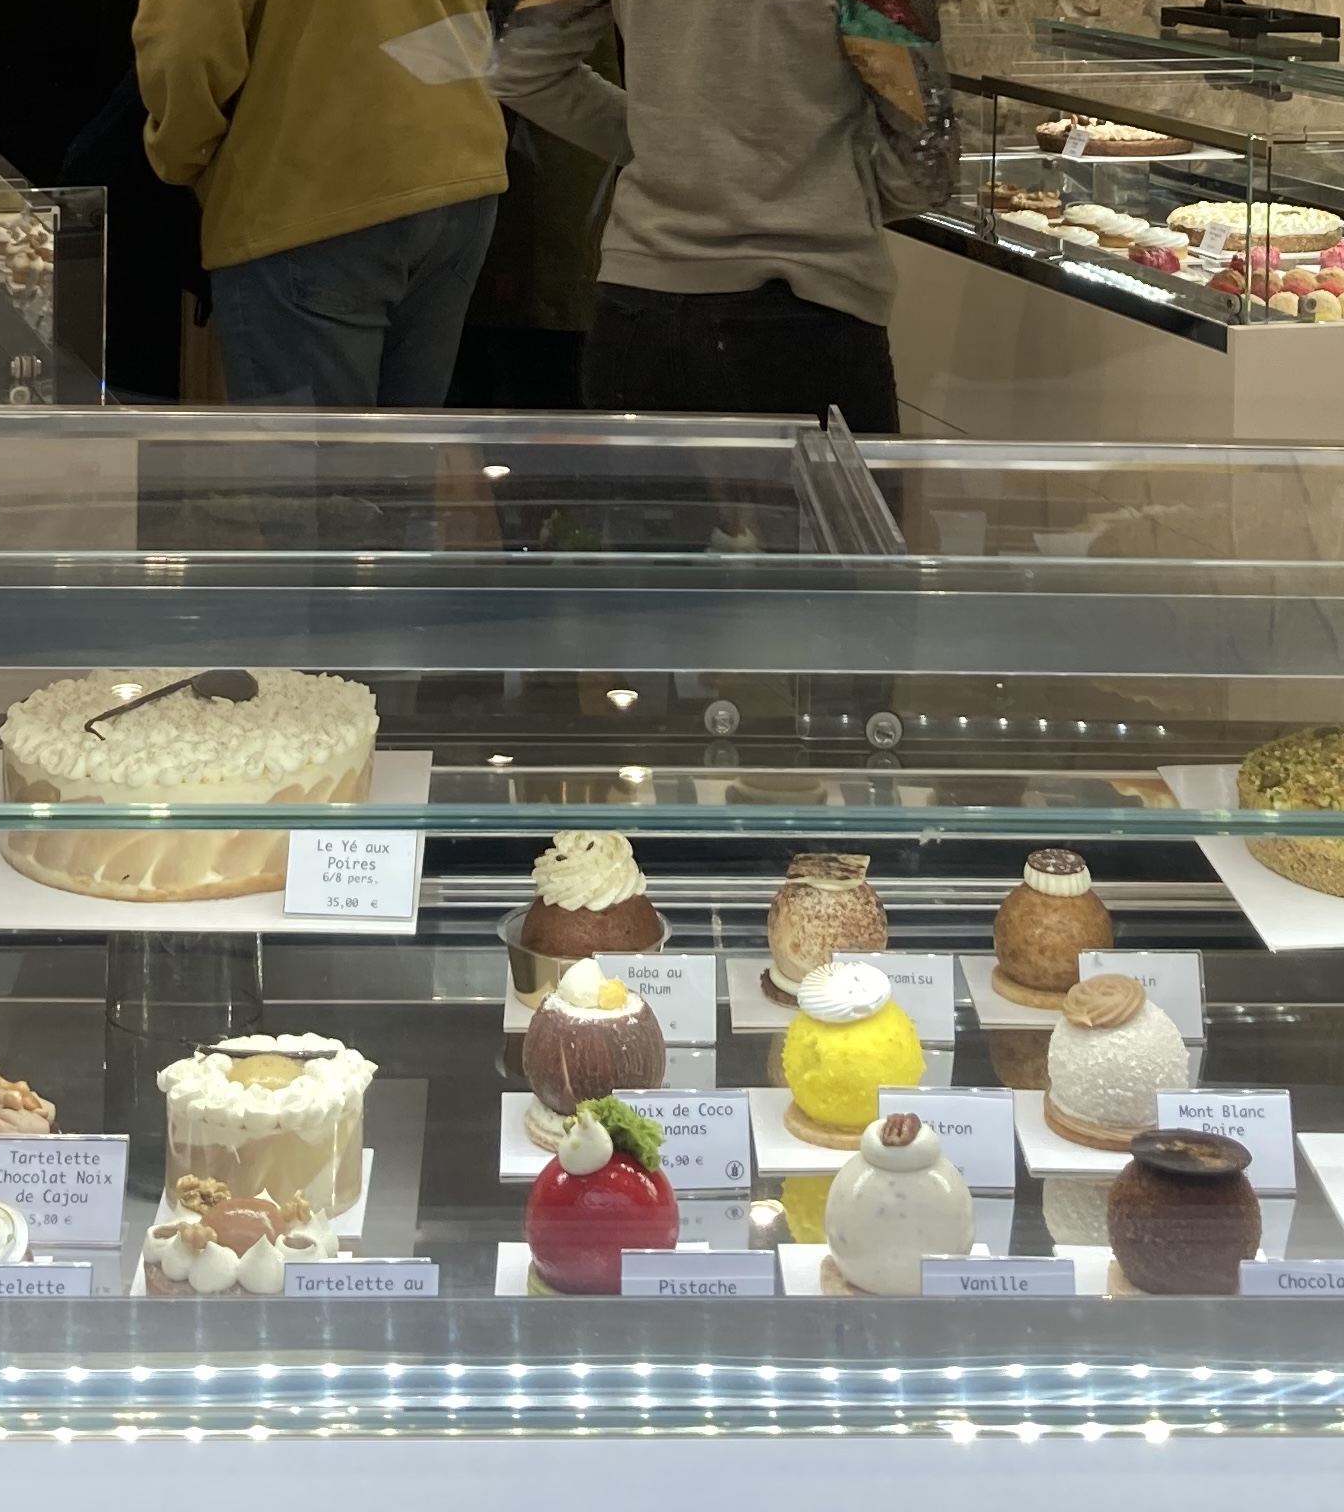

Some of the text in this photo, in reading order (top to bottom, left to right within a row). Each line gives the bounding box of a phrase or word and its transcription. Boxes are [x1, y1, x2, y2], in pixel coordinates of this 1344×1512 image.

[317, 839, 390, 854] Le Yé aux
[327, 856, 377, 870] Poires
[322, 872, 379, 885] 6/8 pers.
[327, 896, 359, 909] 35,00
[628, 966, 682, 978] Baba au
[639, 983, 671, 995] Rhum
[672, 1103, 690, 1117] de
[698, 1102, 734, 1117] Coco
[1179, 1104, 1265, 1119] Mont Blanc
[661, 1124, 707, 1136] nanas
[10, 1150, 100, 1166] Tartelette
[76, 1171, 113, 1185] Noix
[15, 1189, 88, 1206] de Cajou
[29, 1214, 58, 1227] 5,80
[296, 1276, 424, 1291] Tartelette au
[659, 1279, 737, 1295] Pistache
[960, 1276, 1029, 1291] Vanille
